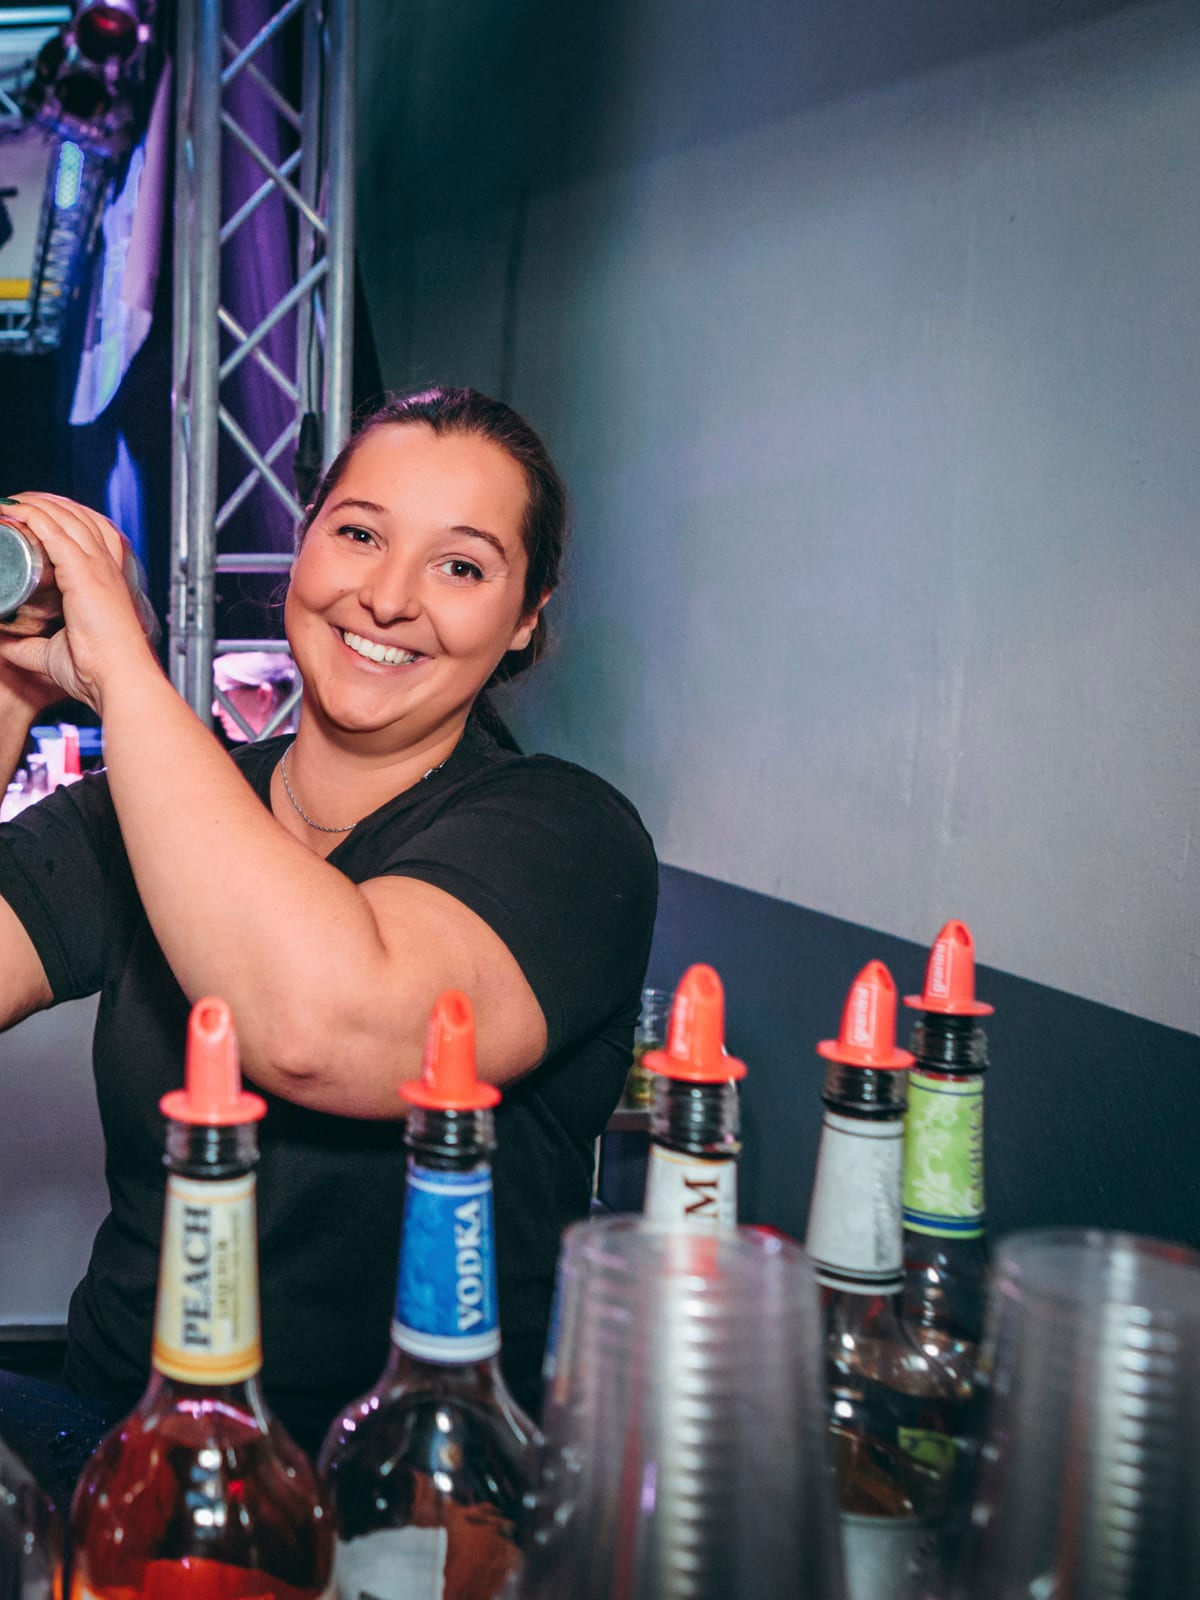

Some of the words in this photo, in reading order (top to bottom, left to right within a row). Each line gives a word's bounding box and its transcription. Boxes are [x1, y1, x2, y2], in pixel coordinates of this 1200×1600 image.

[931, 942, 947, 994] granini
[184, 1206, 211, 1347] PEACH
[454, 1199, 484, 1331] VODKA
